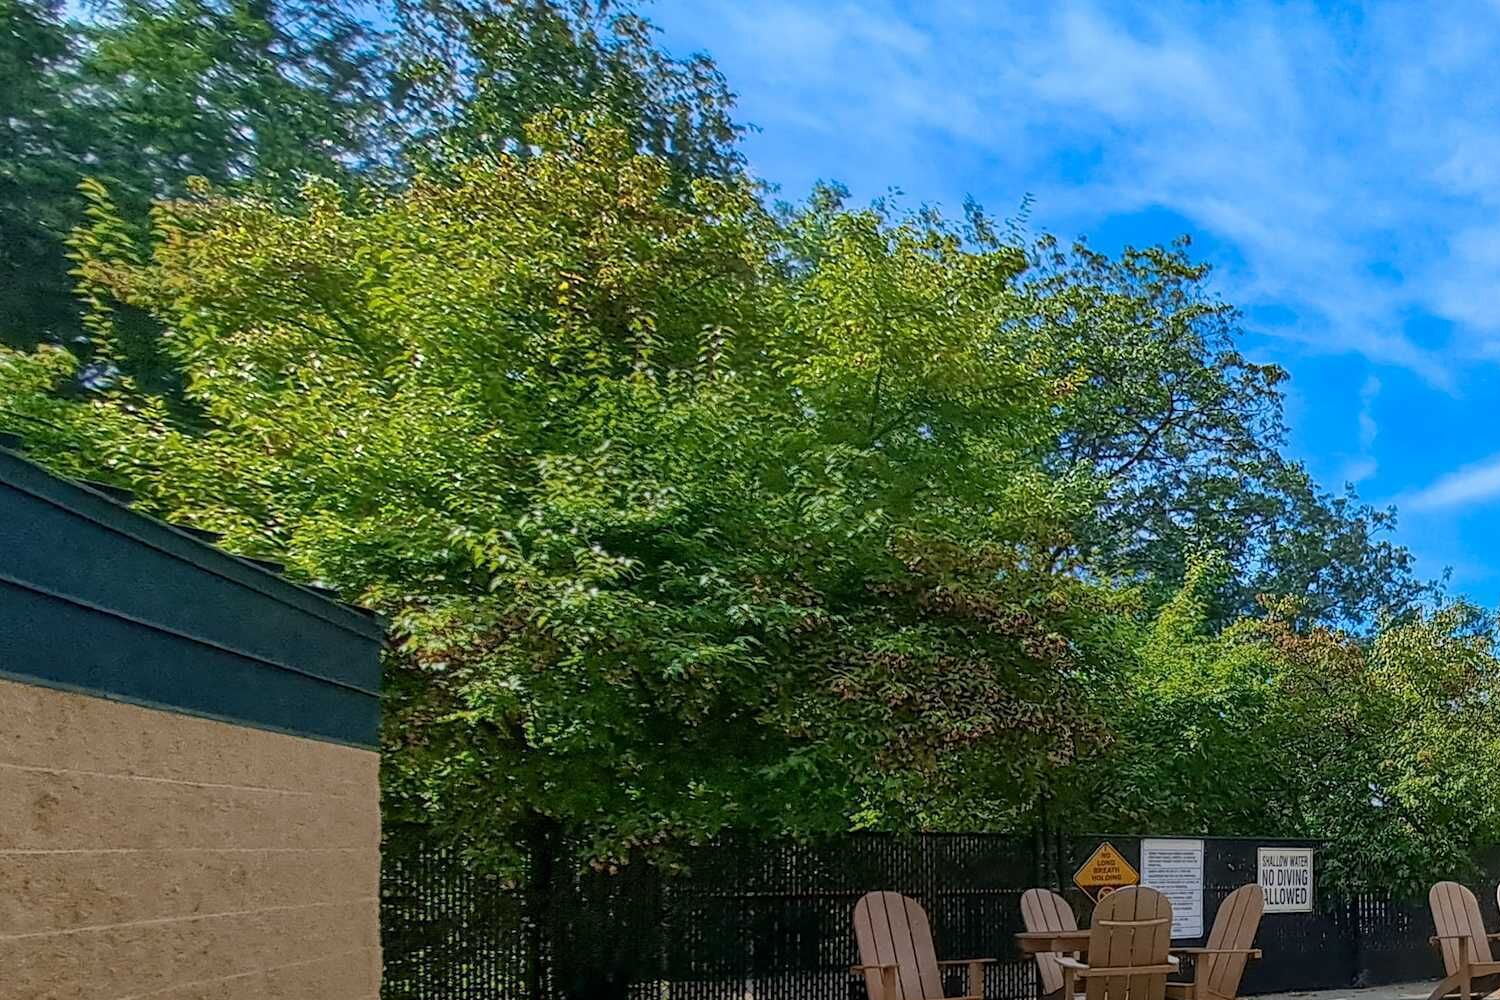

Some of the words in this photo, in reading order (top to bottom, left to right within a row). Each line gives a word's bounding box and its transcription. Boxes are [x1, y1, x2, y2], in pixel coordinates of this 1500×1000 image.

[1262, 855, 1288, 867] SHALLOW
[1289, 855, 1308, 867] WATER
[1262, 869, 1275, 886] NO
[1277, 869, 1308, 886] DIVING
[1264, 888, 1307, 905] ALLOWED
